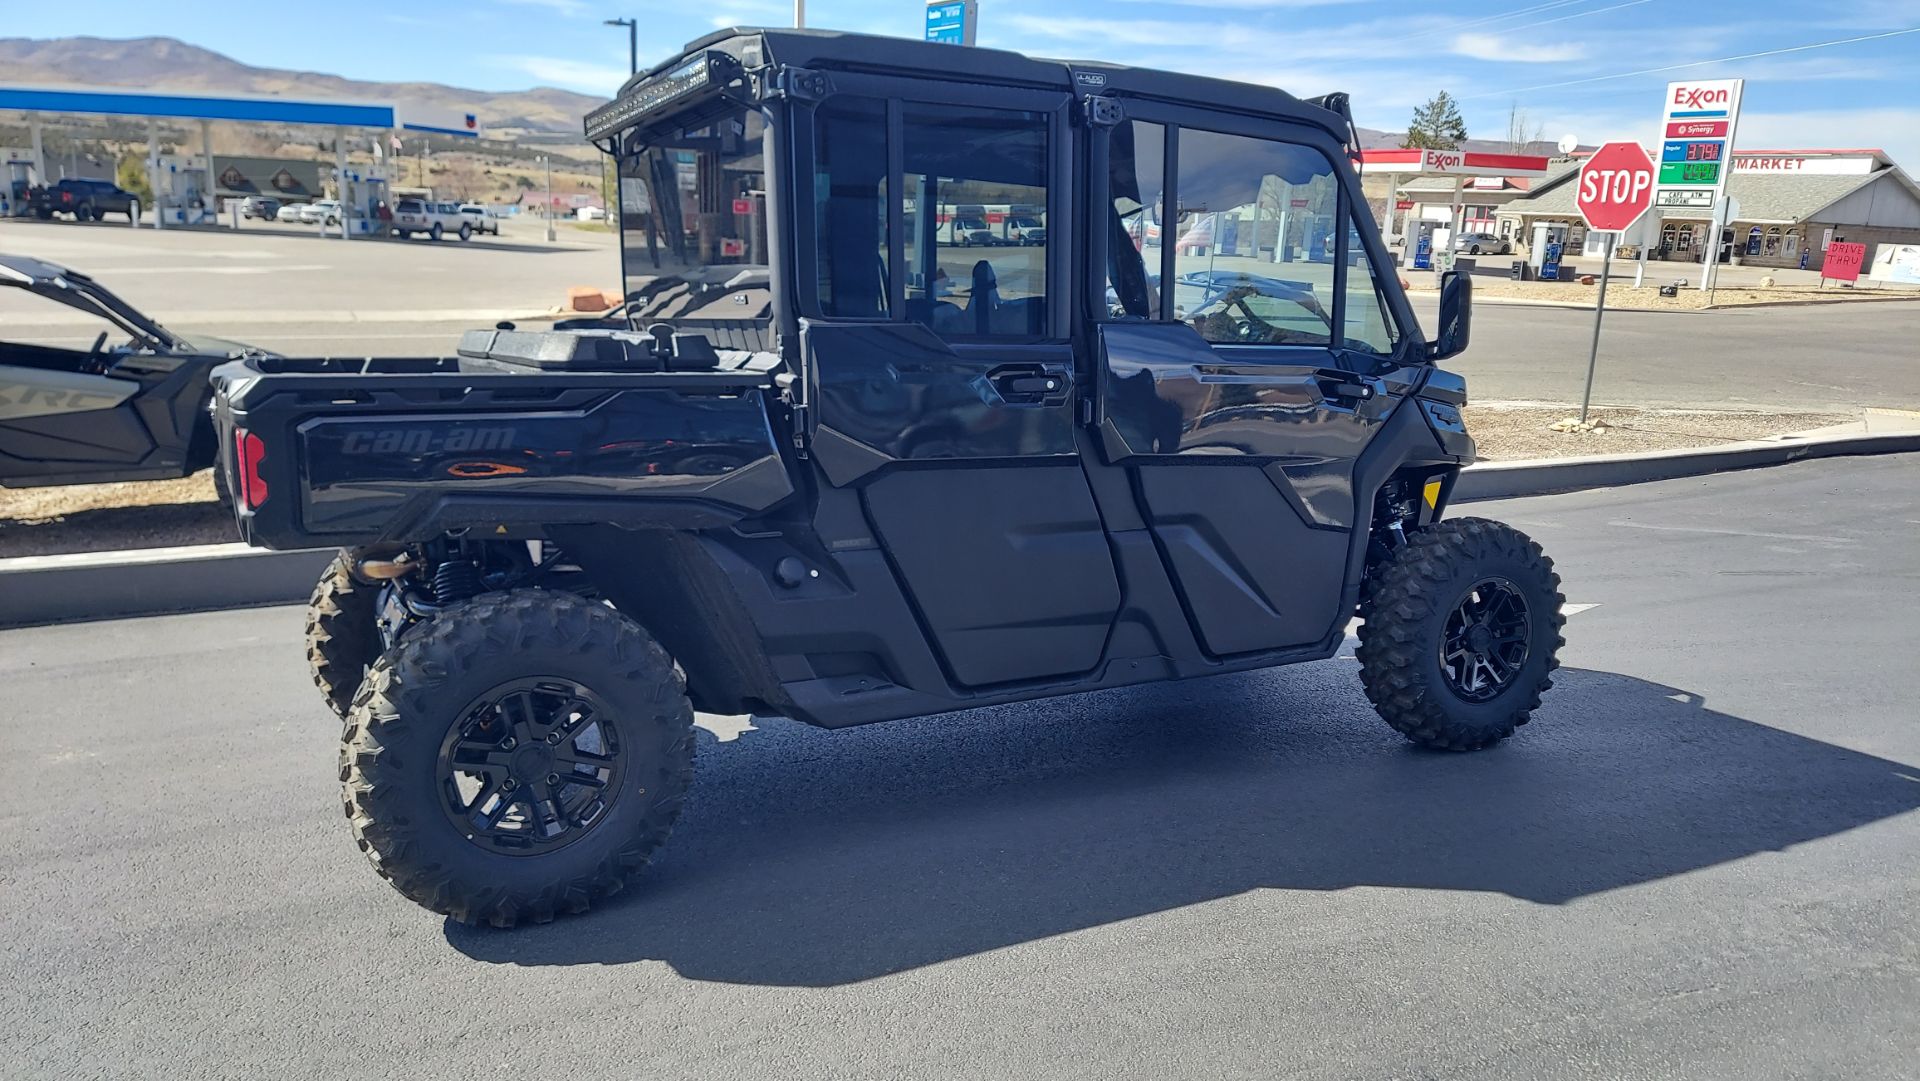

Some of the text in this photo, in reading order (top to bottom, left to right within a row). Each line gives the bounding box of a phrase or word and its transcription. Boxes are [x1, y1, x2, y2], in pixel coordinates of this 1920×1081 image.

[1674, 87, 1728, 109] Exxon
[1688, 125, 1715, 134] Synergy
[1426, 151, 1460, 171] Exxon
[1736, 158, 1805, 170] MARKET
[1581, 169, 1651, 204] STOP
[1831, 243, 1864, 255] DRIVE
[1827, 254, 1859, 265] THRU
[341, 427, 517, 454] can-am
